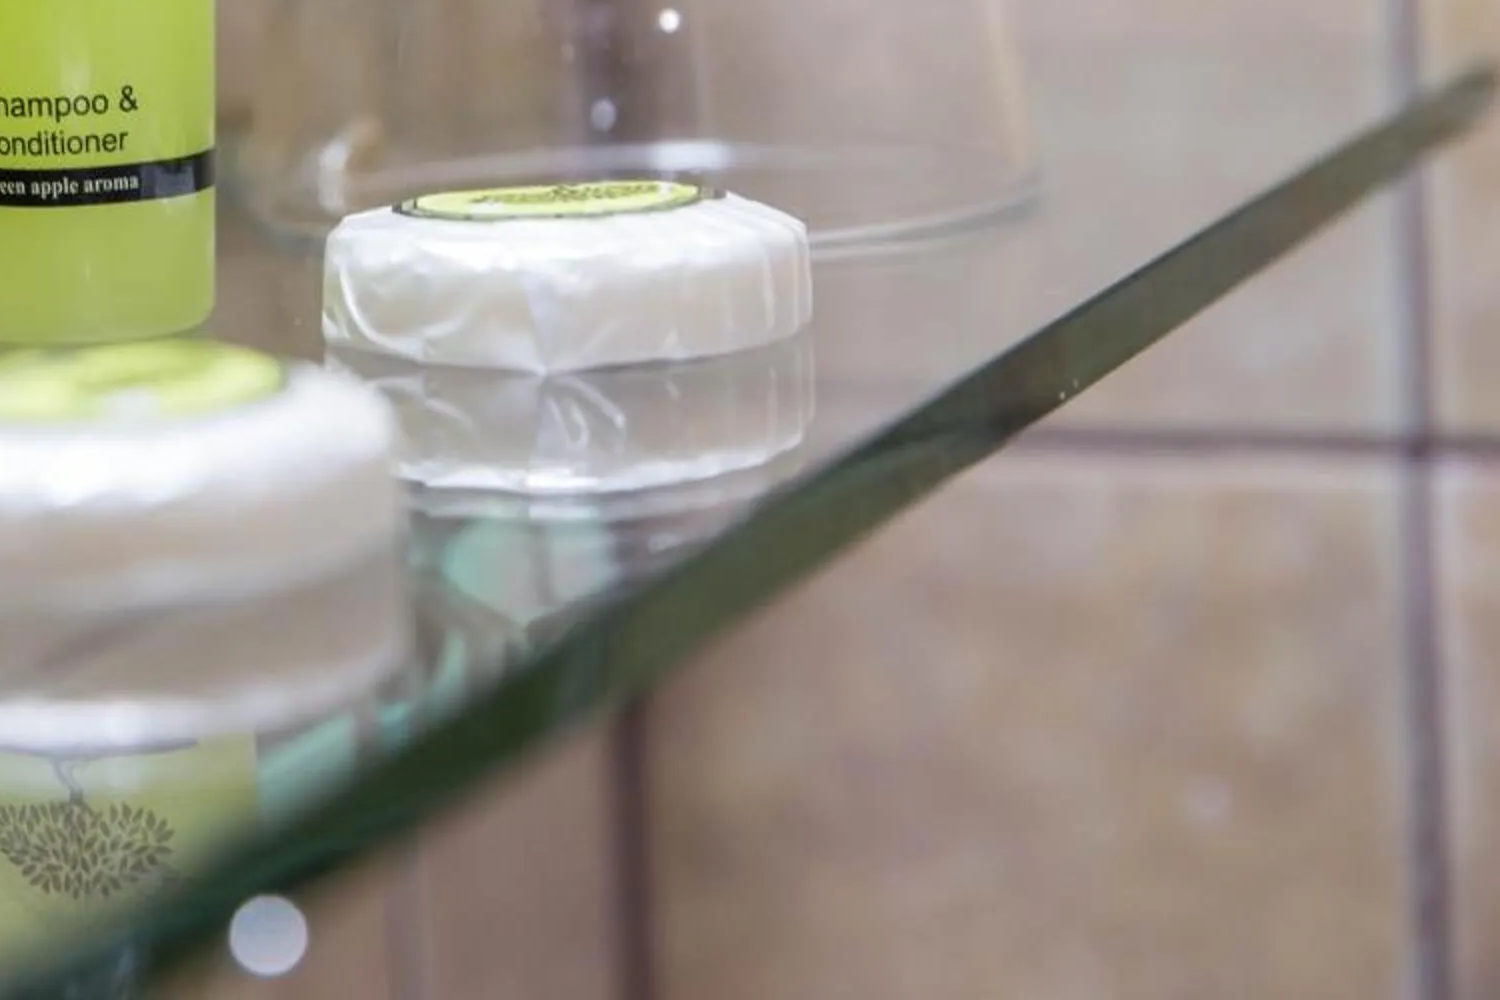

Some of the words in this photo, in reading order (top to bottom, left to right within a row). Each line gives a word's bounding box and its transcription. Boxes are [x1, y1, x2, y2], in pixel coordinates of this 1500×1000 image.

[118, 85, 139, 113] &
[31, 176, 79, 200] apple
[84, 175, 140, 194] aroma
